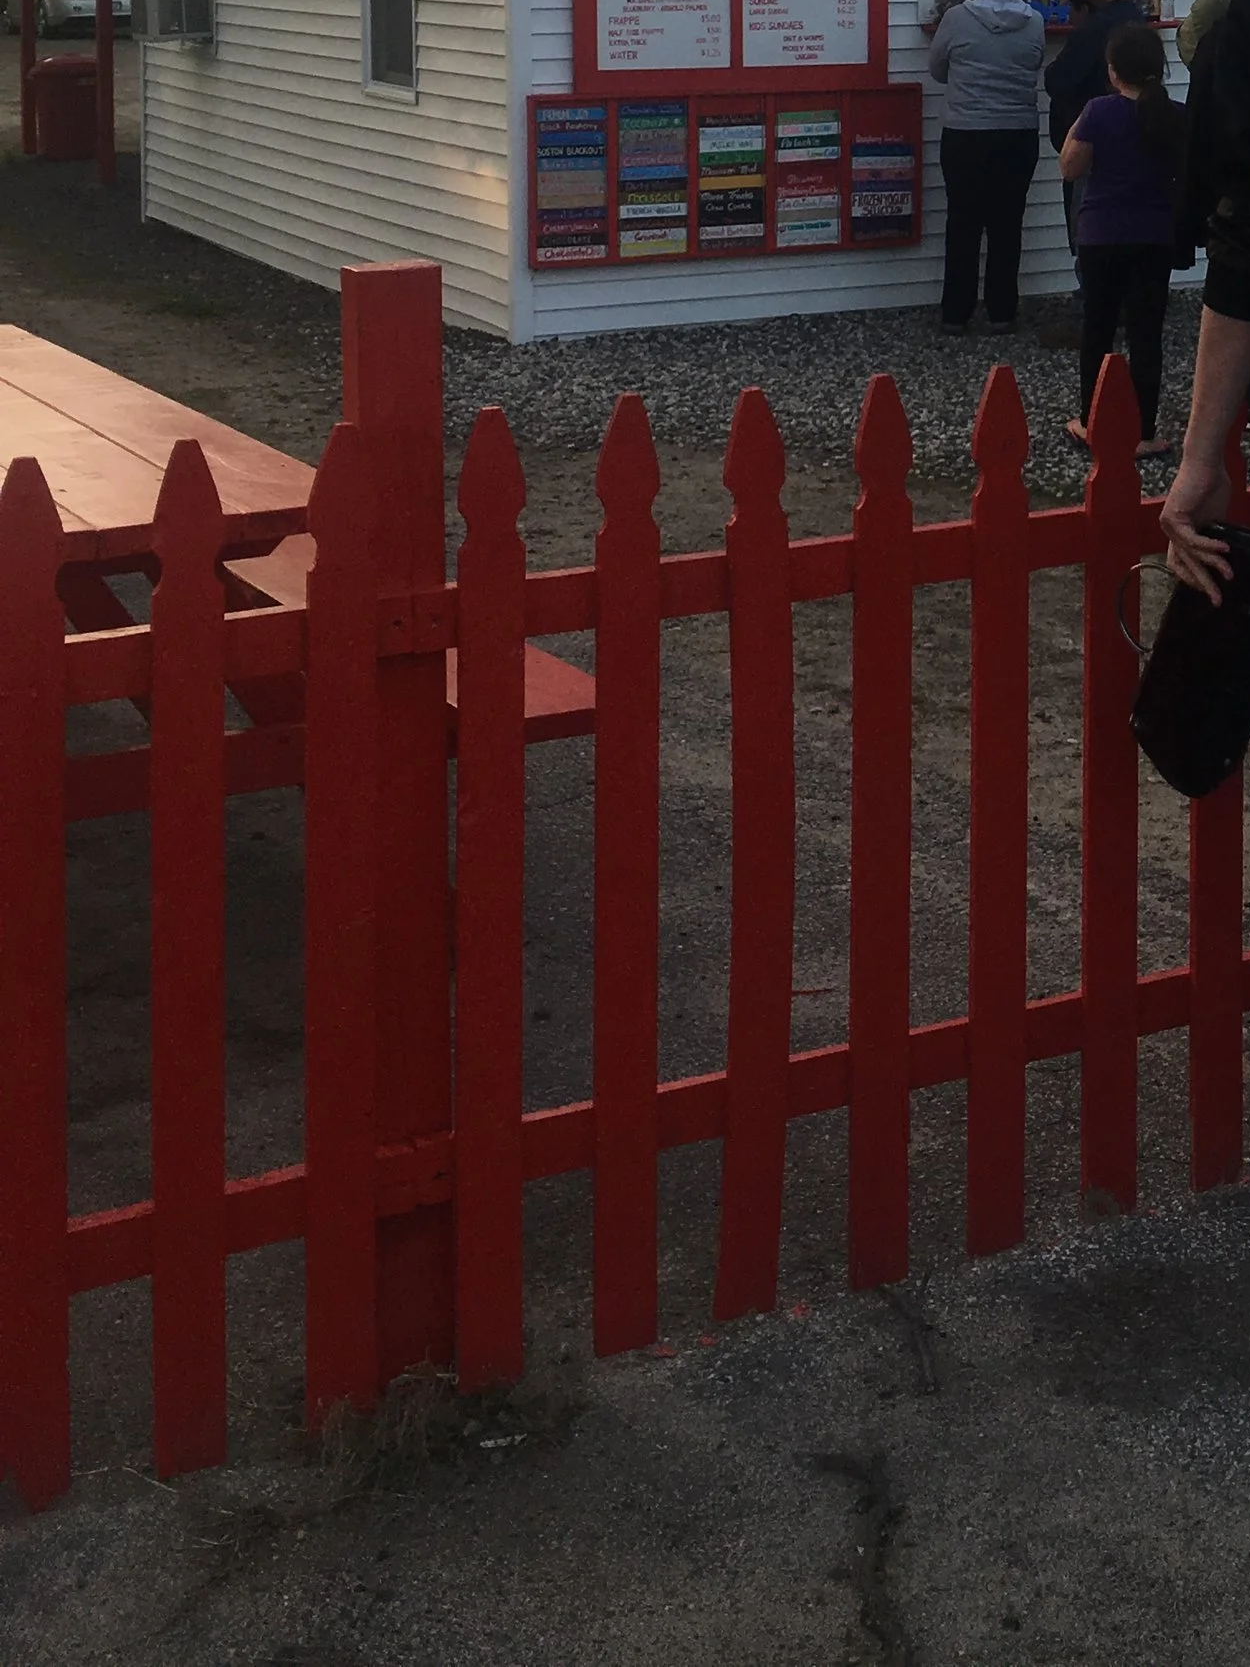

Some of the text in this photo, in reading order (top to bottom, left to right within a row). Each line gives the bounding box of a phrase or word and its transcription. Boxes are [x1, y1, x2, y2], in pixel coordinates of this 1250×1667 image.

[608, 16, 640, 26] FRAPPE
[749, 21, 765, 30] KIDS
[768, 21, 804, 30] SUNDAES
[609, 51, 638, 60] WATER
[537, 145, 605, 157] BOSTON BLACKOUT
